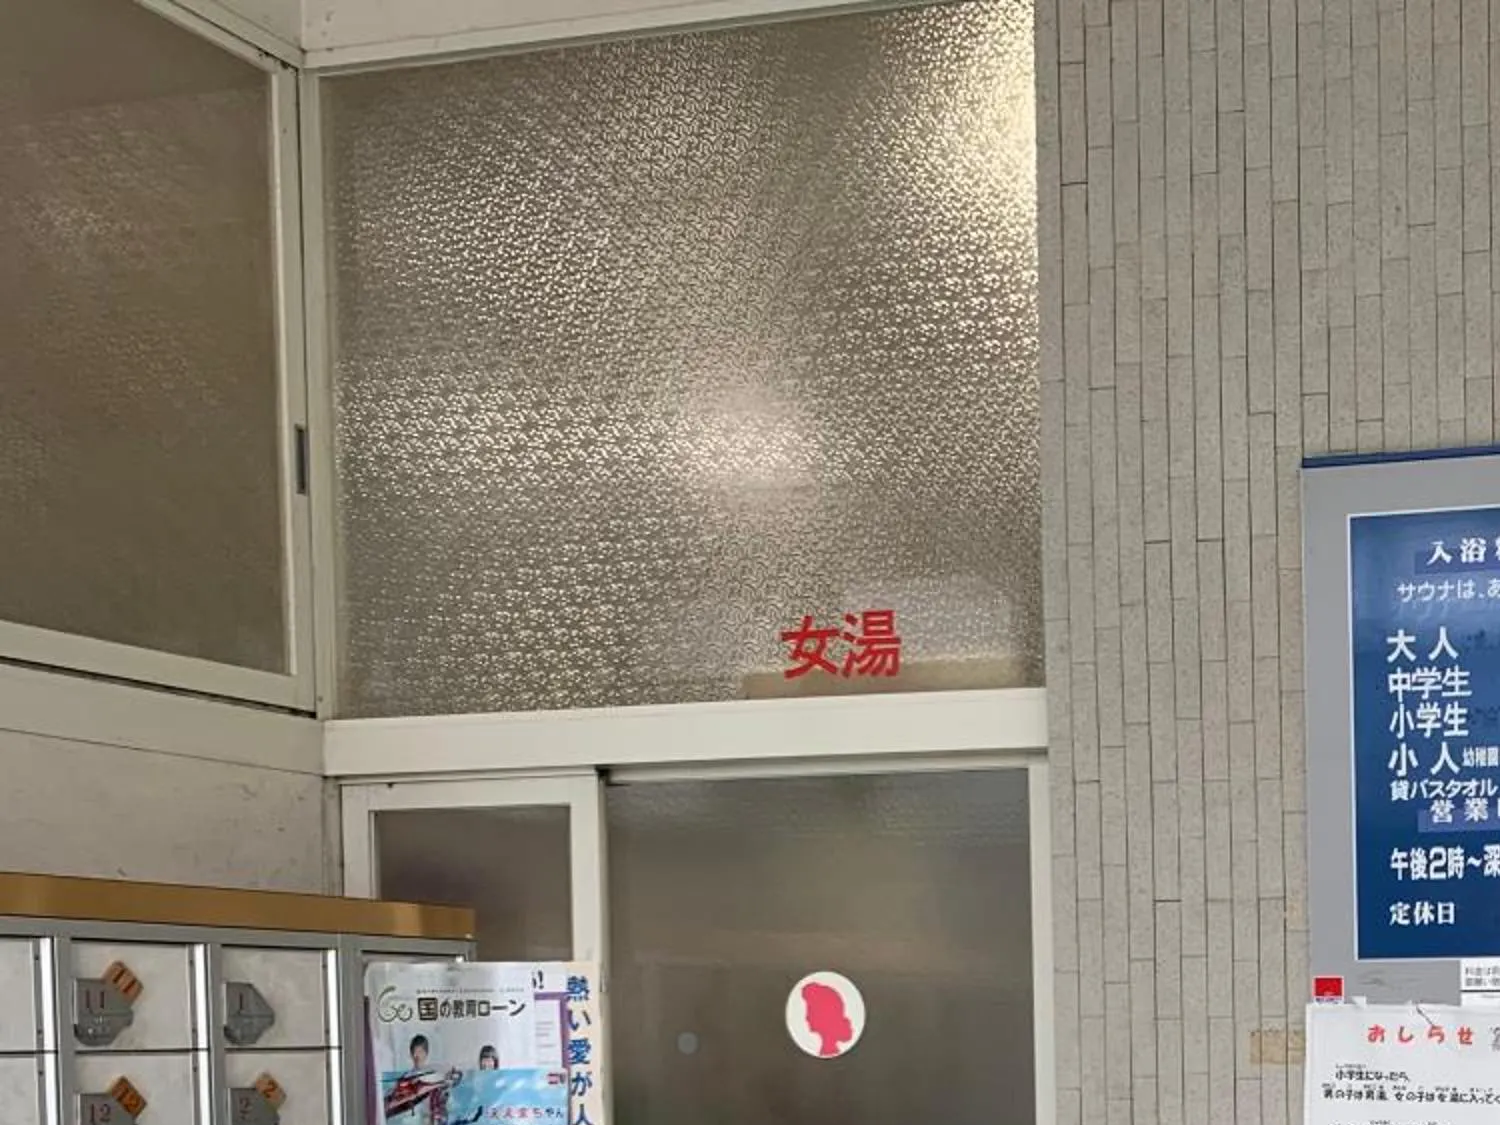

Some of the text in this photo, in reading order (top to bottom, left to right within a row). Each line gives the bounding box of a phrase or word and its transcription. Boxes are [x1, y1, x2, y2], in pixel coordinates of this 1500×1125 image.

[780, 610, 902, 679] 女湯
[1386, 626, 1460, 663] 大人
[1387, 666, 1472, 702] 中学生
[1389, 704, 1470, 739] 小学生
[1387, 741, 1461, 777] 小人
[1389, 777, 1498, 802] 貸バスタオル
[1389, 901, 1456, 927] 定休日
[417, 997, 526, 1021] 国の教育ローン
[1367, 1025, 1475, 1046] おしらせ
